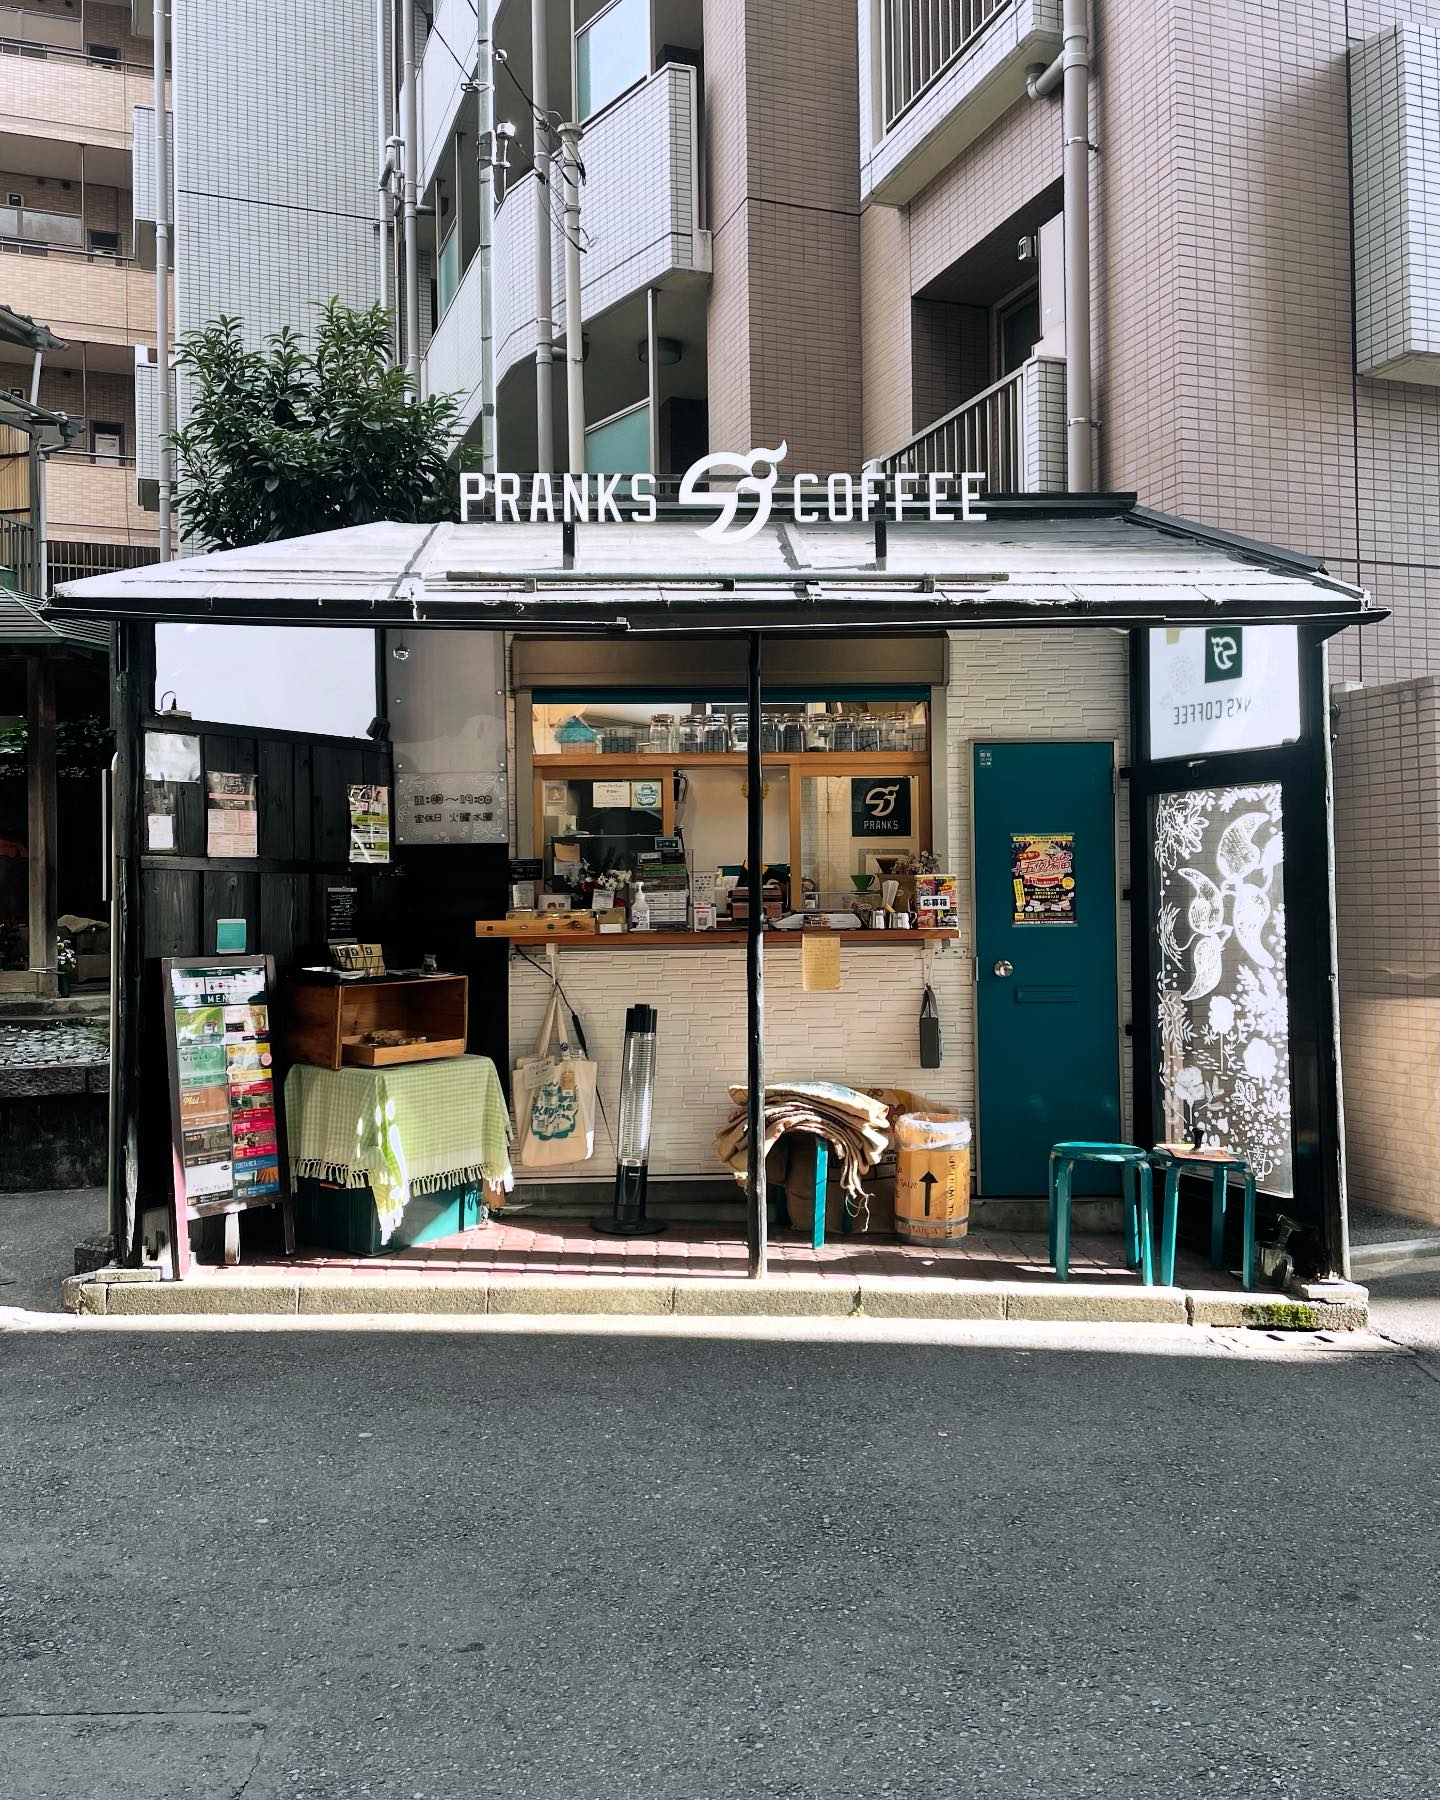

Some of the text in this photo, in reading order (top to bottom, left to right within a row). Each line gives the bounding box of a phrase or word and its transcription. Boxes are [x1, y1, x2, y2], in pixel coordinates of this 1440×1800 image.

[460, 472, 987, 523] PRANKS COFFEE
[863, 820, 899, 830] PRANKS
[207, 994, 235, 1004] MEN
